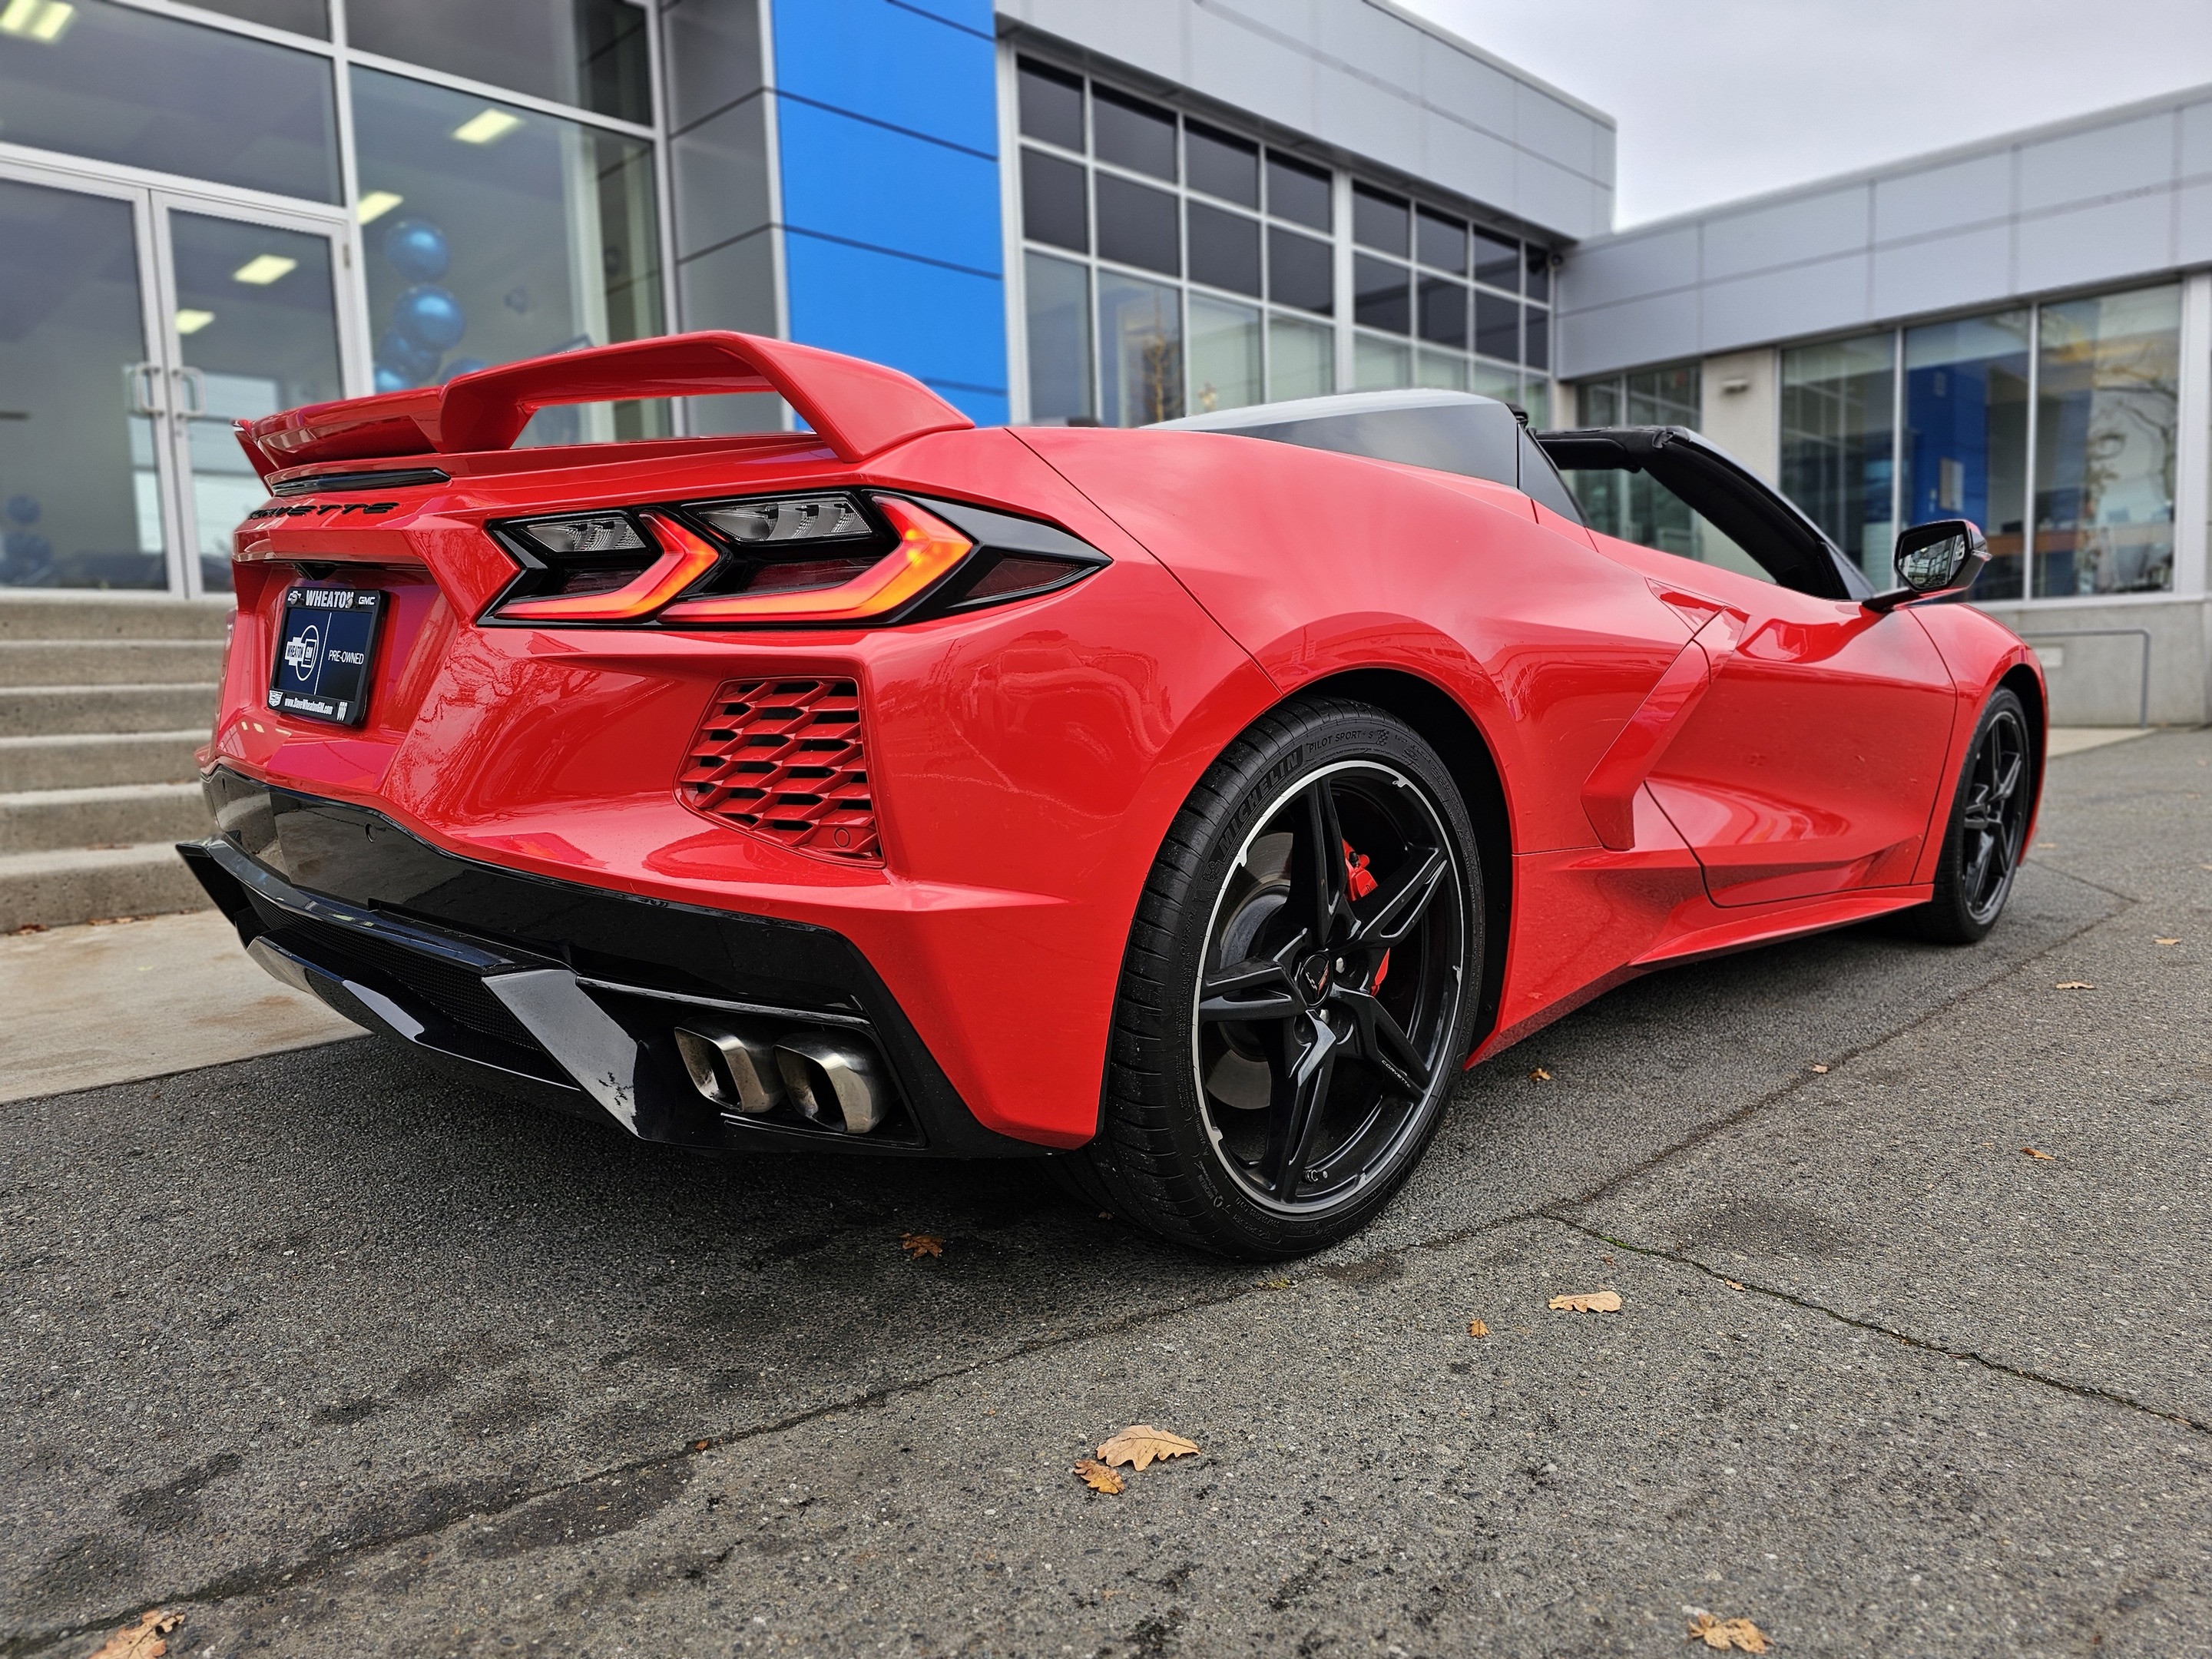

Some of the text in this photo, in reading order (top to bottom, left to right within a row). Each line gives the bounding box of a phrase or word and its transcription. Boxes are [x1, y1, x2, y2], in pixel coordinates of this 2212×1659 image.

[248, 502, 399, 520] ORVETTE
[306, 589, 355, 609] WHEATON
[358, 596, 376, 605] GMC
[287, 645, 304, 658] WHEATON
[328, 650, 365, 665] PRE-OWNED
[1306, 734, 1333, 753] PILOT
[1335, 730, 1363, 742] SPORT
[1218, 751, 1299, 856] MICHELIN
[1180, 908, 1198, 956] OUTSIDE
[1381, 1059, 1412, 1088] CORVETTE
[1196, 1174, 1215, 1200] MICHELIN
